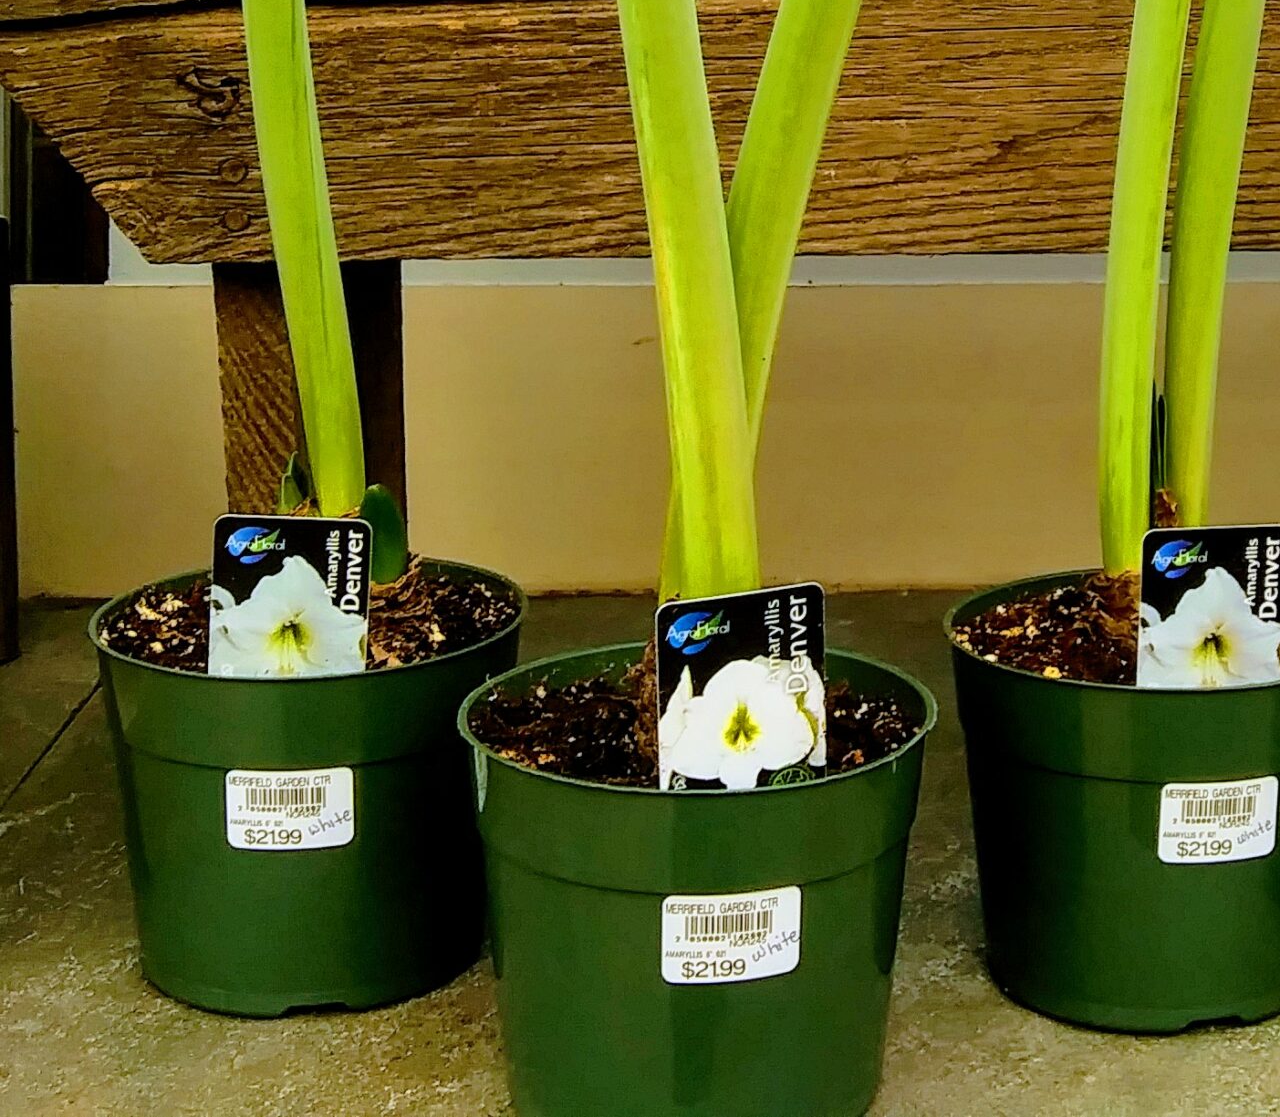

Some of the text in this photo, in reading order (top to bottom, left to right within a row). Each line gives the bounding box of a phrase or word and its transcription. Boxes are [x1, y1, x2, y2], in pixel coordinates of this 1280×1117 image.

[324, 529, 342, 598] Amaryllis
[340, 529, 364, 611] Denver
[1244, 537, 1260, 607] Amaryllis
[1258, 536, 1280, 619] Denver
[764, 598, 784, 683] Amaryllis
[786, 595, 807, 695] Denver
[228, 774, 332, 788] MERRIFIELD GARDEN CTR
[1165, 784, 1262, 799] MERRIFIELD GARDEN CTR
[308, 810, 352, 836] white
[1237, 820, 1273, 844] white
[665, 897, 778, 914] MERRIFIELD GARDEN CTR
[752, 930, 800, 962] white
